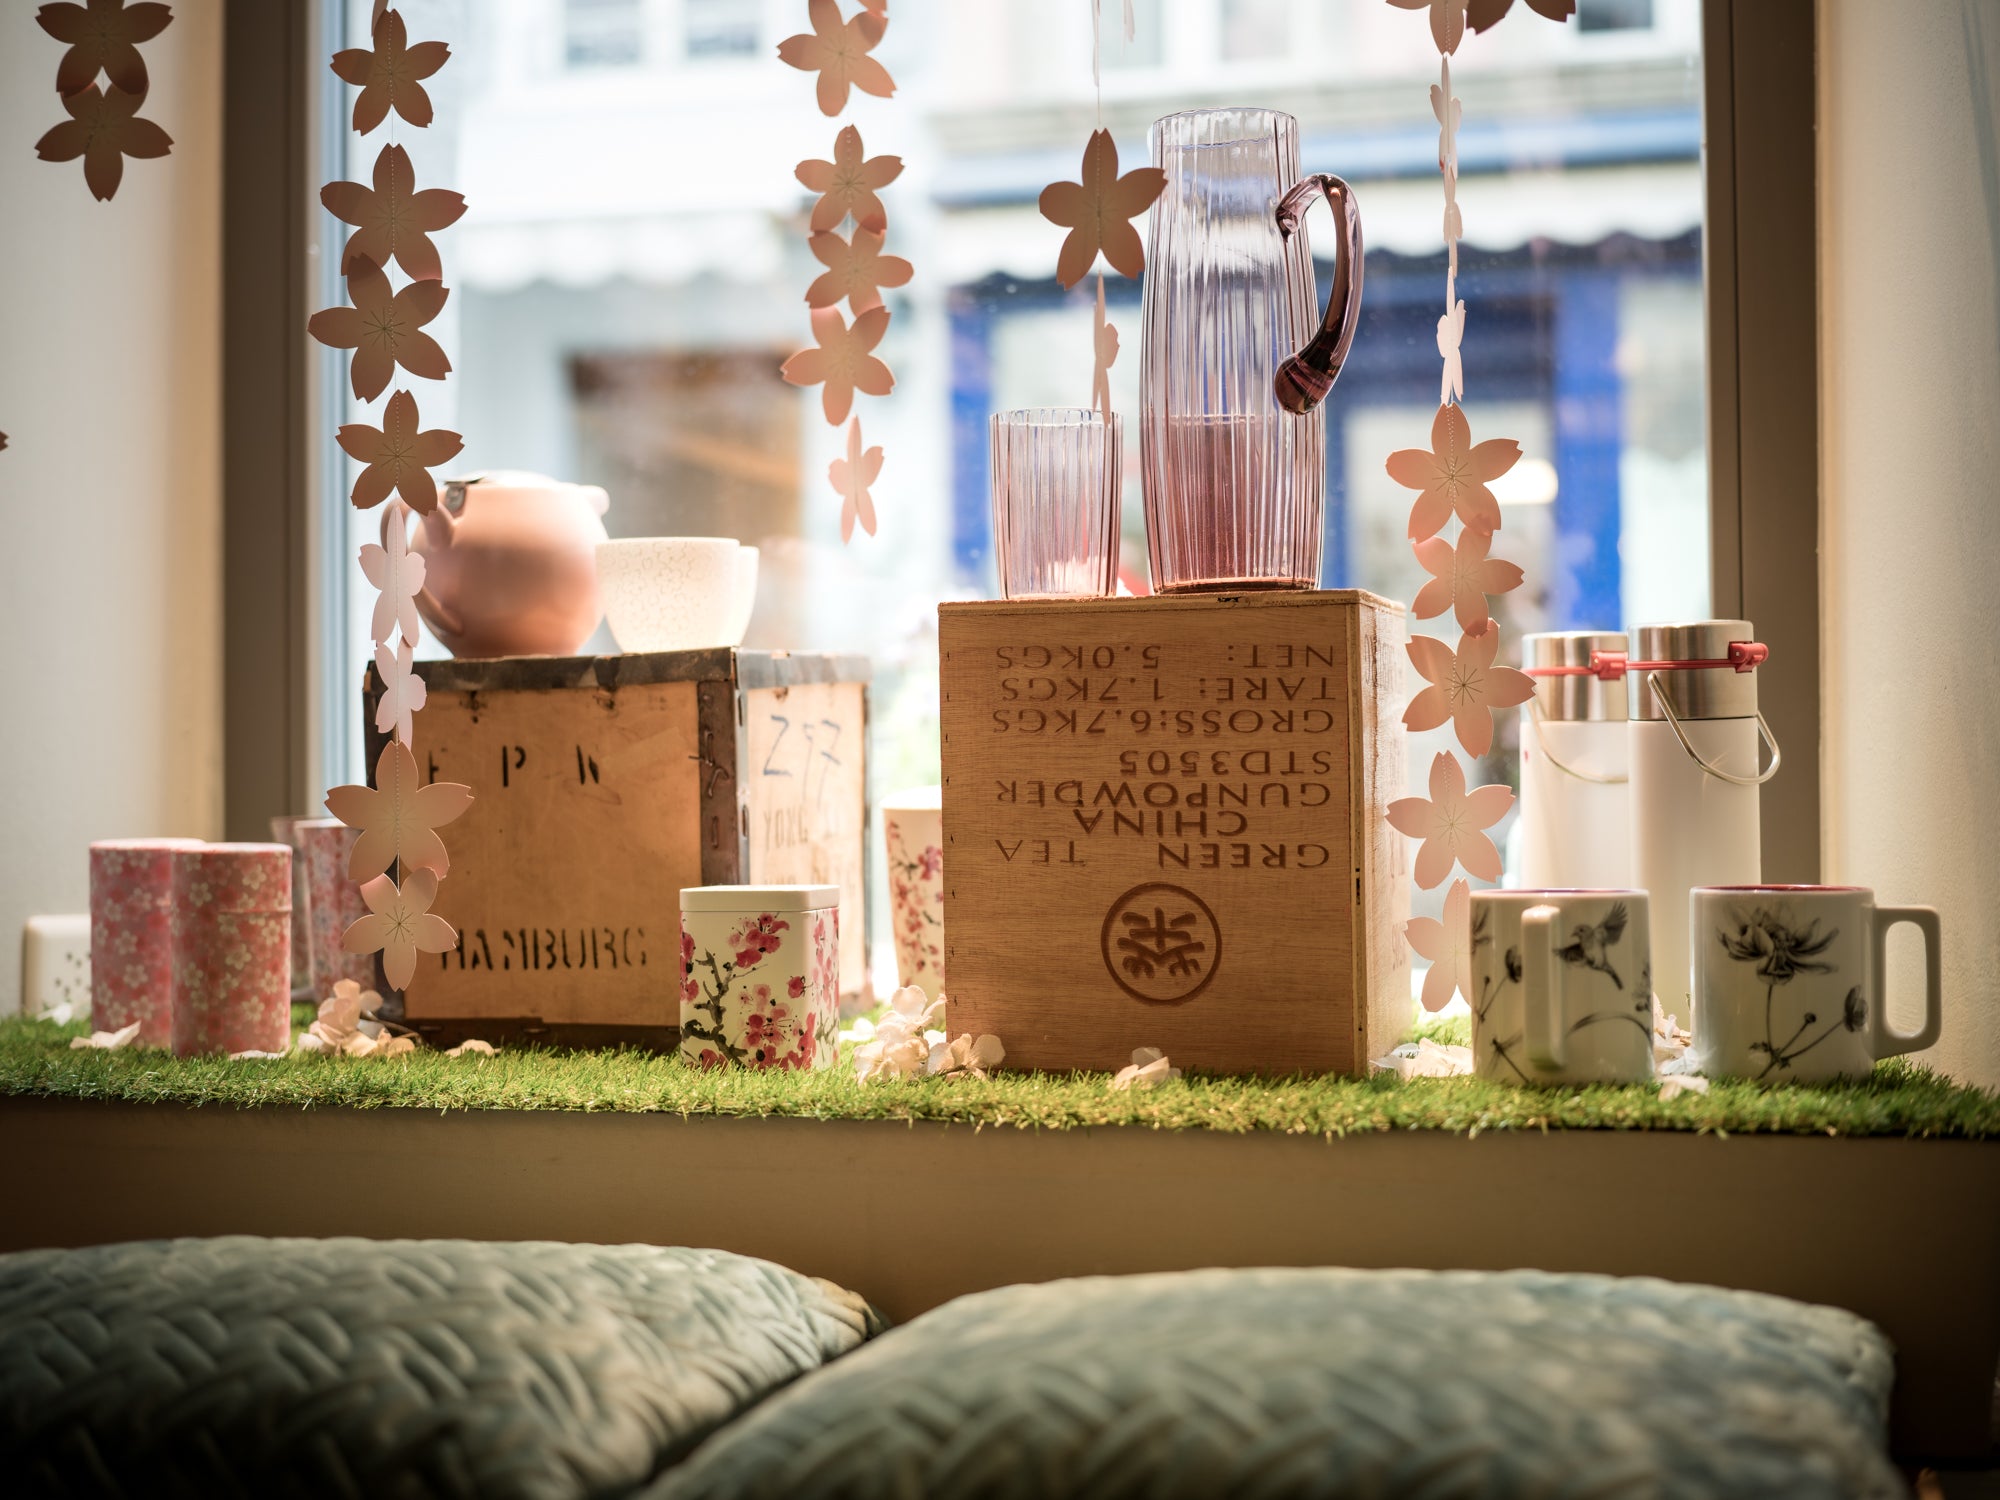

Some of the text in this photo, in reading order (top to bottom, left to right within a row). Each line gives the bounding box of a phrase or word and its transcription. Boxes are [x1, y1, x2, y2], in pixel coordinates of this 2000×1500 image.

[996, 644, 1333, 669] NET: 5.0KGS
[1001, 676, 1336, 702] TARE: 1.7KGS
[501, 743, 527, 788] P
[1118, 749, 1332, 777] STD3505
[994, 779, 1331, 809] GUNPOWDER
[1072, 807, 1249, 838] CHINA
[994, 838, 1088, 868] TEA
[1157, 841, 1331, 870] GREEN
[441, 927, 647, 971] HAMBURG
